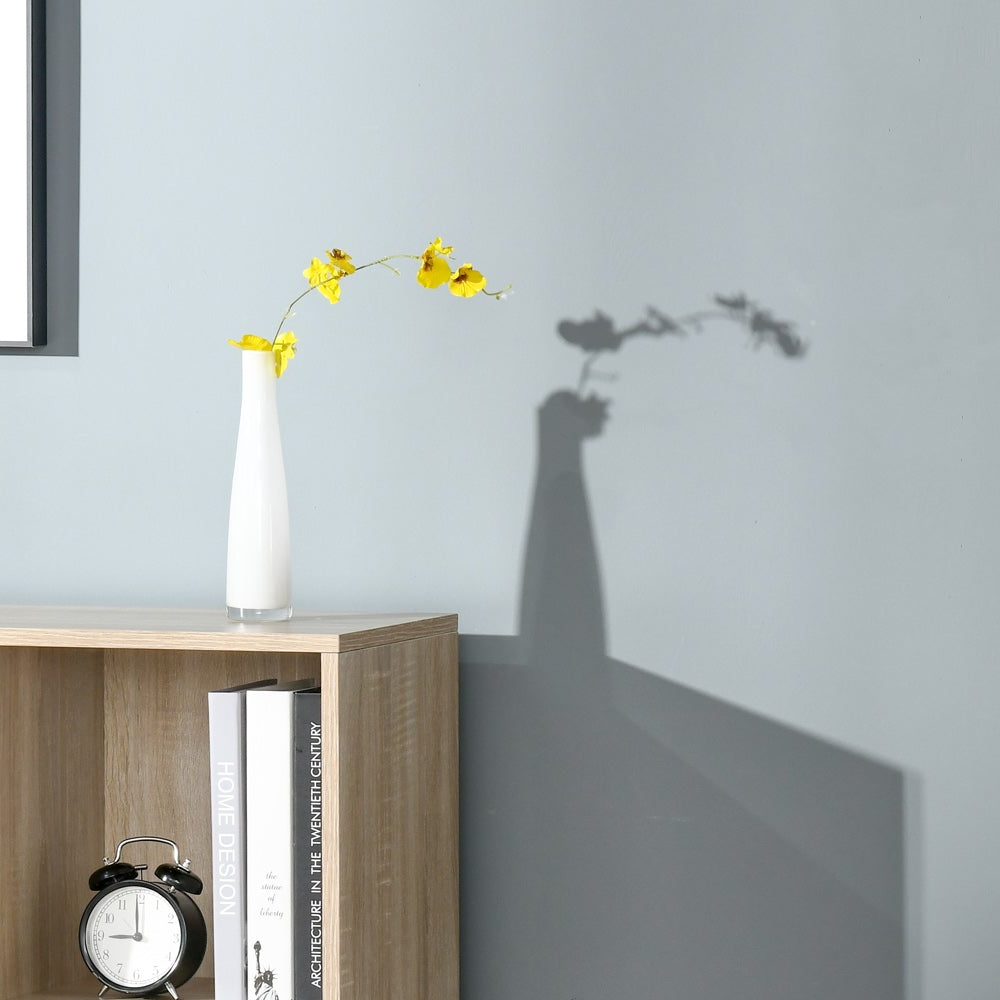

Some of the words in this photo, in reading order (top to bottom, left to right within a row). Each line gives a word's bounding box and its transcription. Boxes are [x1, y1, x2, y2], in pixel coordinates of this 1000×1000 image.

[310, 721, 321, 778] CENTURY
[217, 761, 234, 825] HOME
[310, 780, 321, 847] TWENTIETH
[310, 852, 321, 874] THE
[310, 881, 321, 893] IN
[310, 900, 321, 988] ARCHITECTURE
